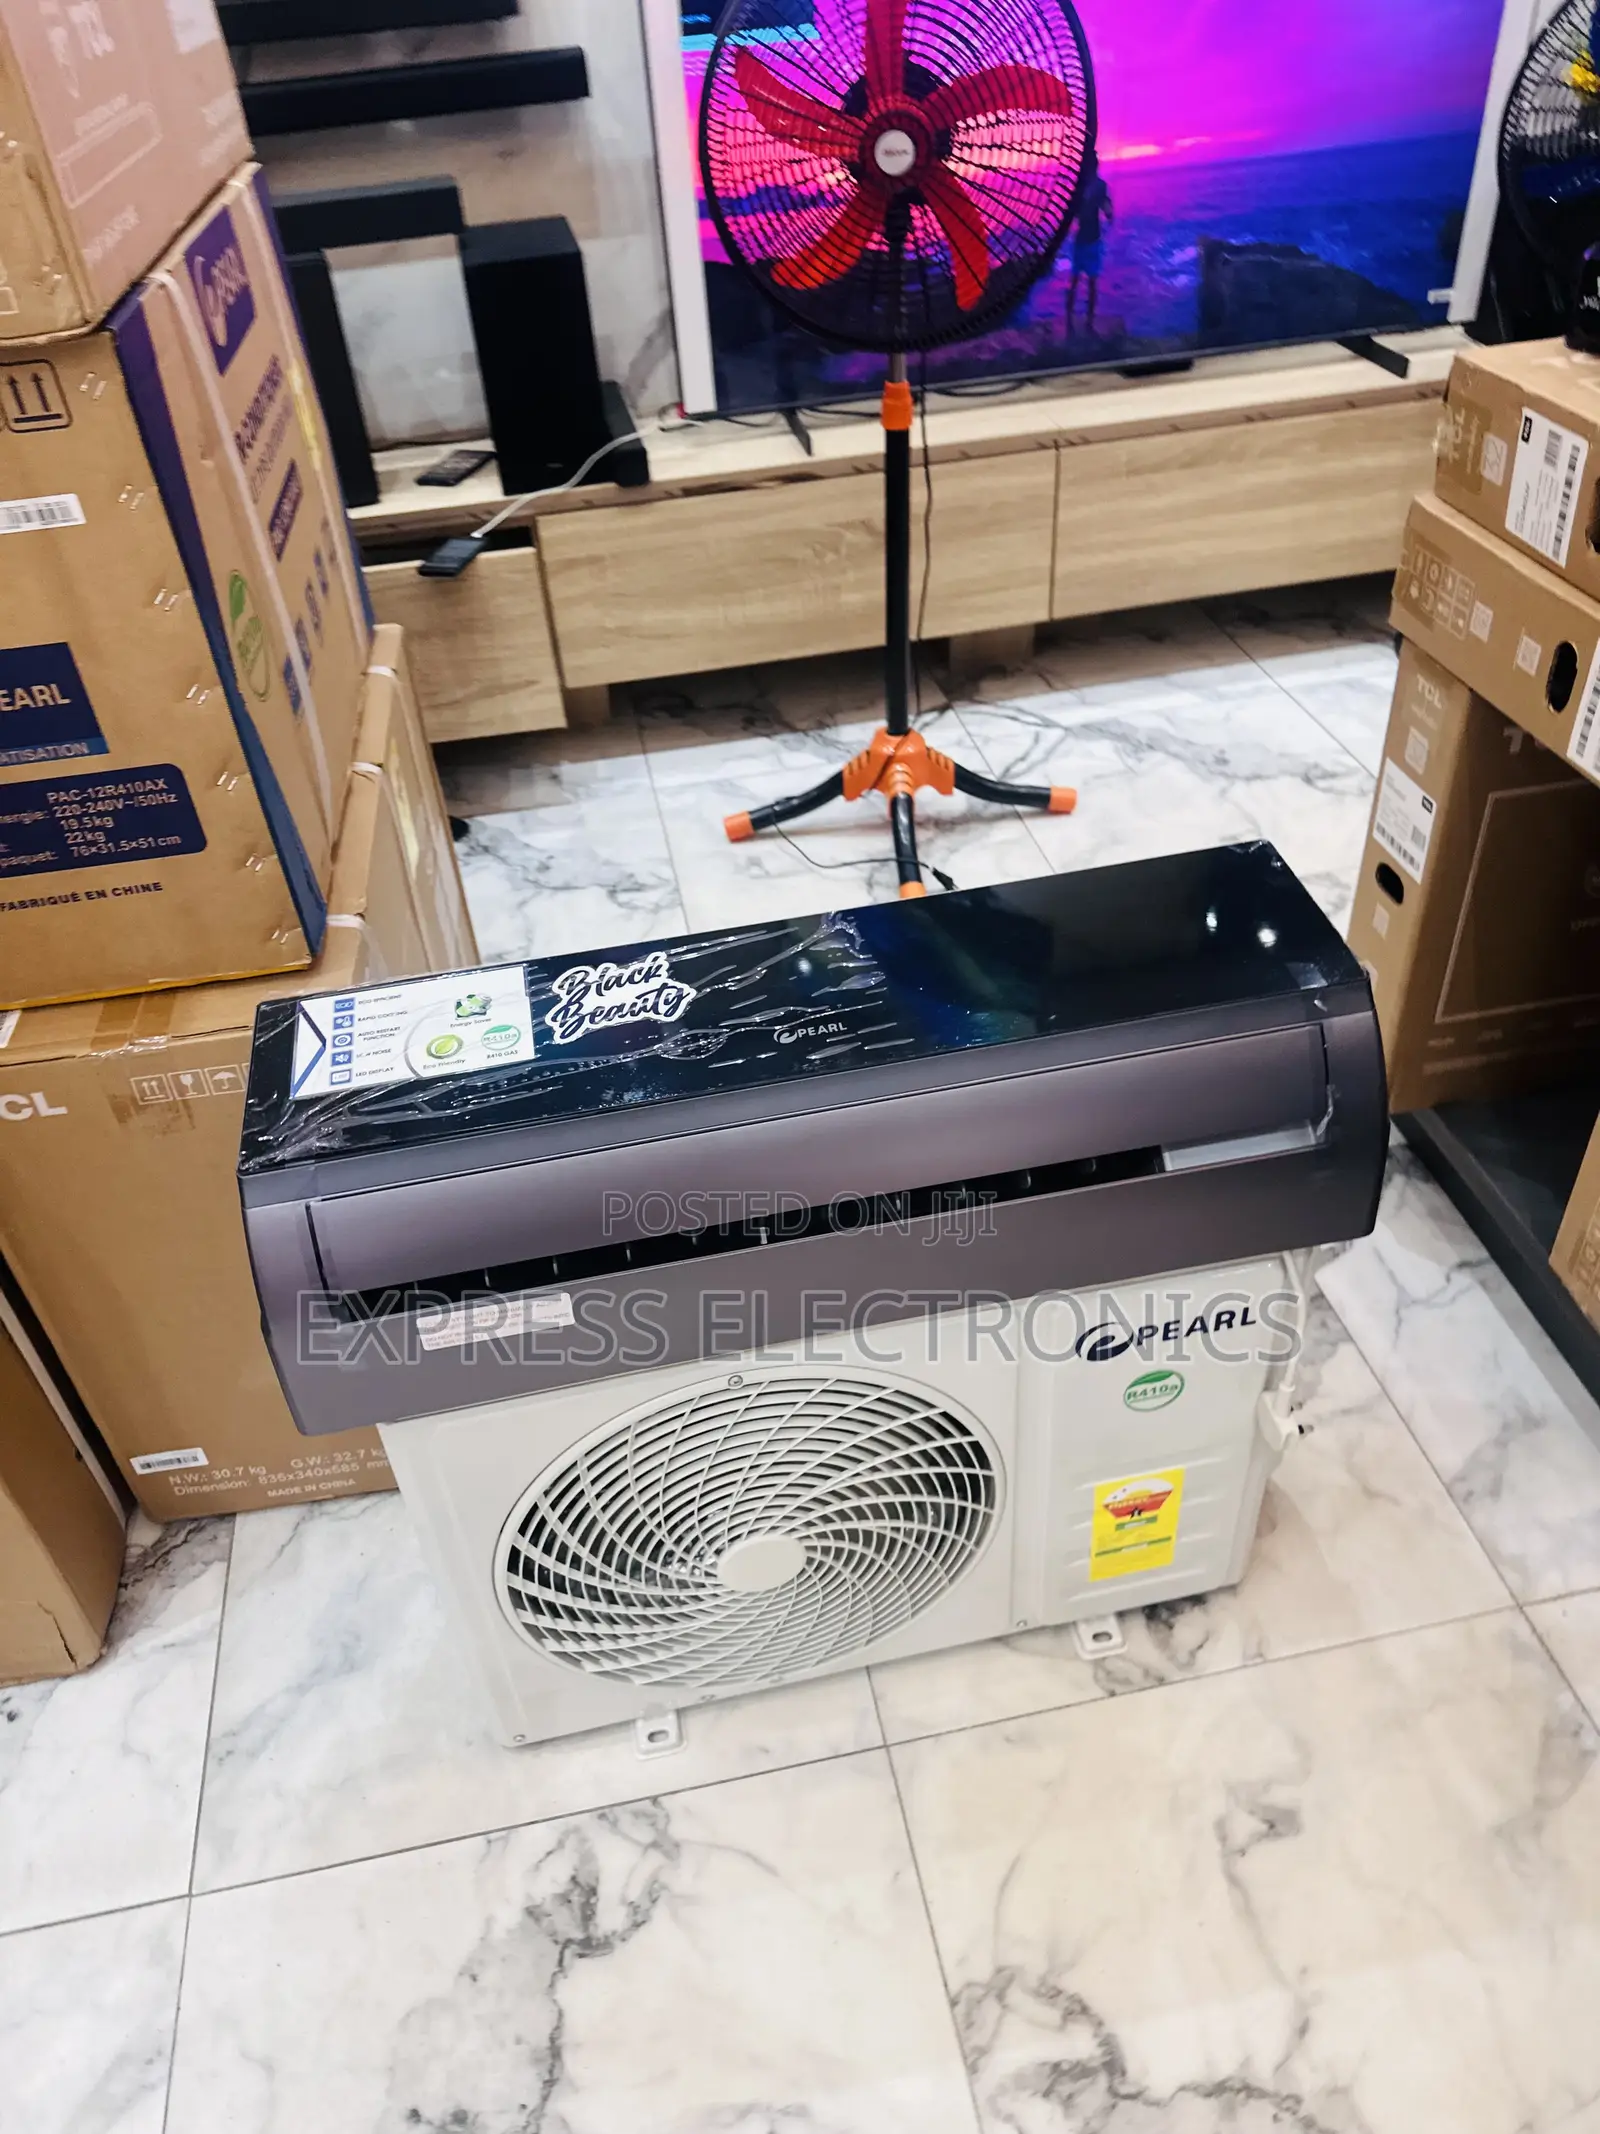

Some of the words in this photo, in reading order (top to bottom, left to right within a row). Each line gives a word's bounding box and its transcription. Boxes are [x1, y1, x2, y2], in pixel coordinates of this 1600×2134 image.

[1417, 673, 1442, 709] TCL
[46, 778, 169, 804] PAC-12R410AX
[84, 889, 107, 900] EN
[111, 881, 163, 897] CHINE
[557, 954, 664, 1004] Black
[551, 982, 692, 1040] Beauty
[797, 1022, 848, 1038] PEARL
[1136, 1307, 1257, 1347] PEARL
[1126, 1383, 1179, 1400] R410a
[211, 1466, 244, 1479] 30.7
[333, 1448, 365, 1462] 32.7
[267, 1485, 302, 1497] MADE
[304, 1484, 317, 1492] IN
[319, 1478, 356, 1490] CHINA
